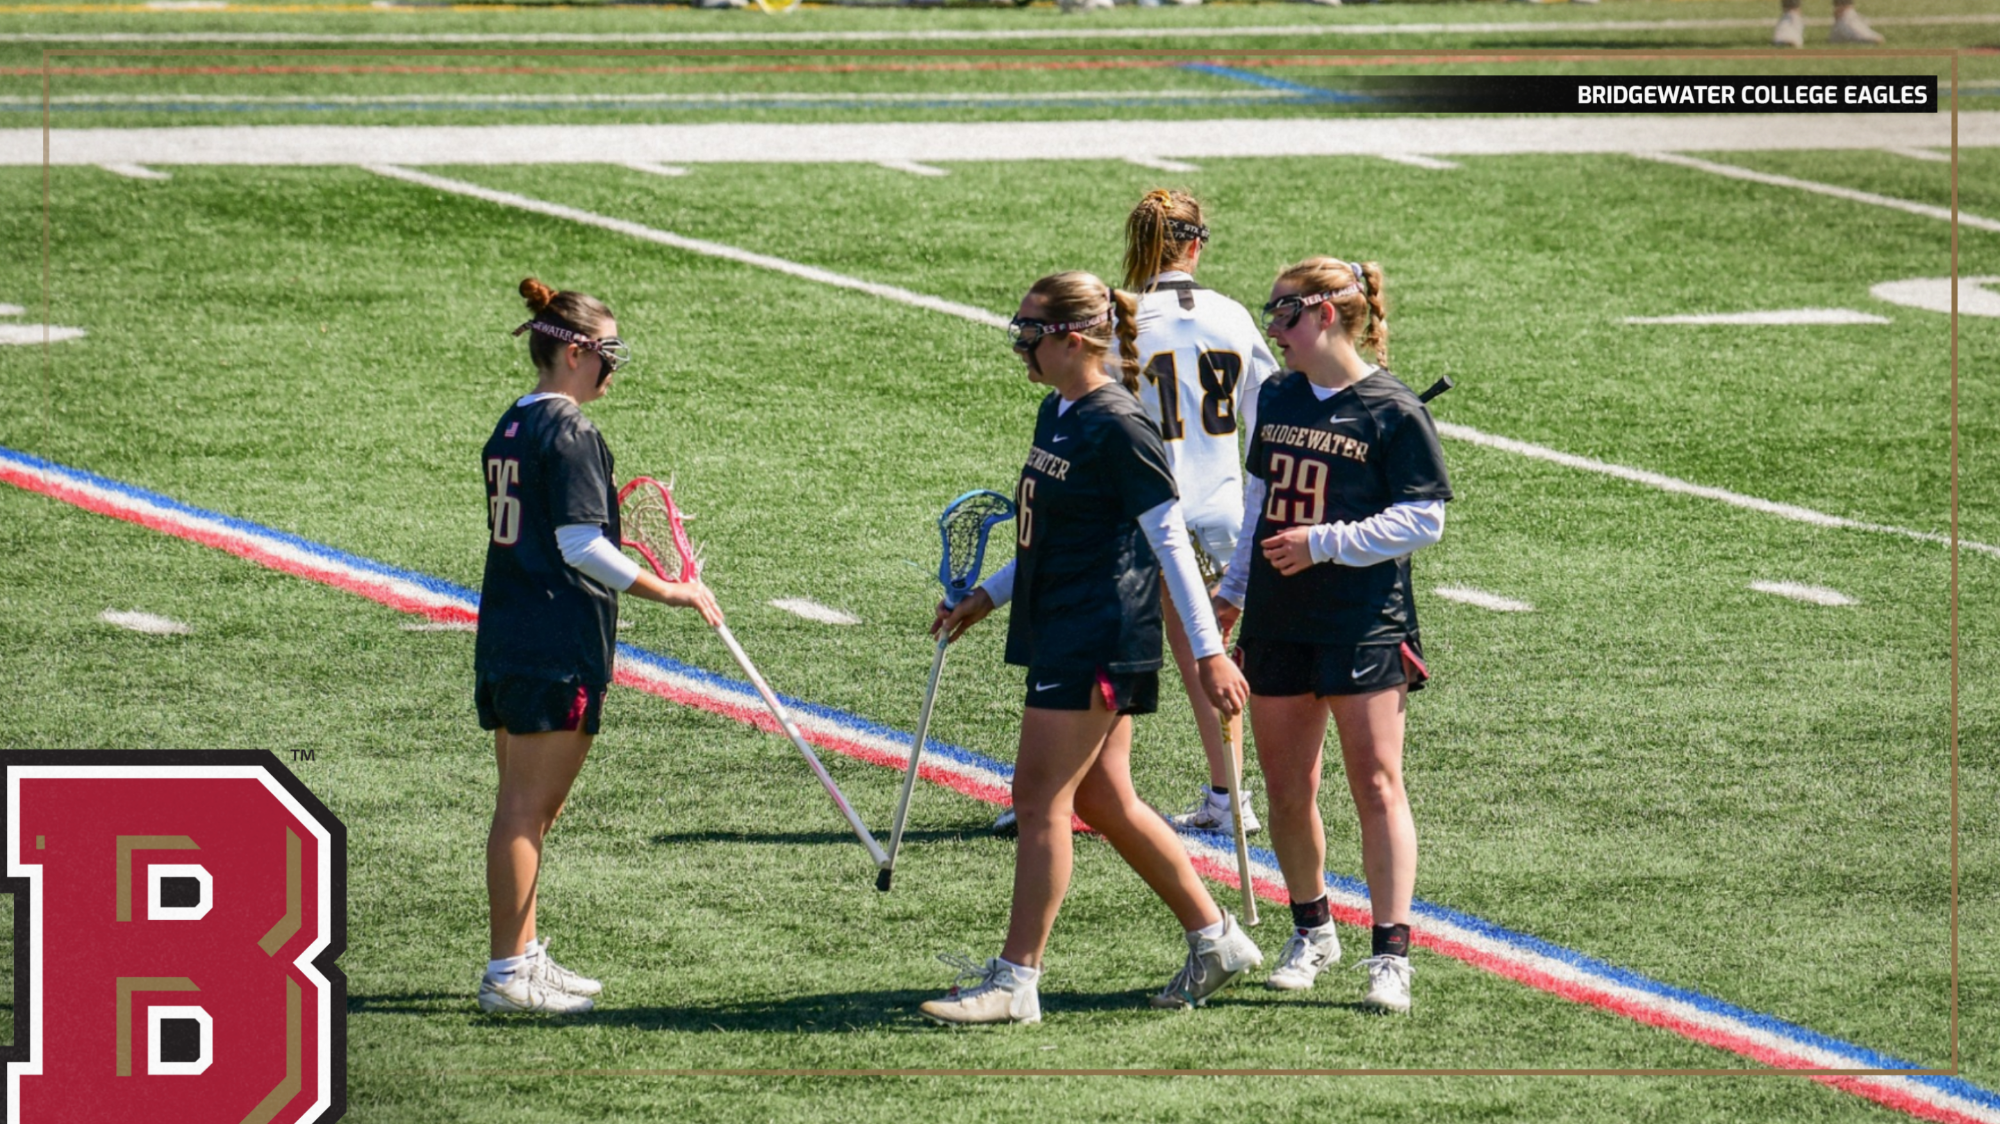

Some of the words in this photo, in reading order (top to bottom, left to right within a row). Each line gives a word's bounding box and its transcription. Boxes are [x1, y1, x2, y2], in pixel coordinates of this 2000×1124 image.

[1143, 349, 1243, 442] 18
[1017, 477, 1036, 548] 6
[1266, 452, 1328, 525] 29
